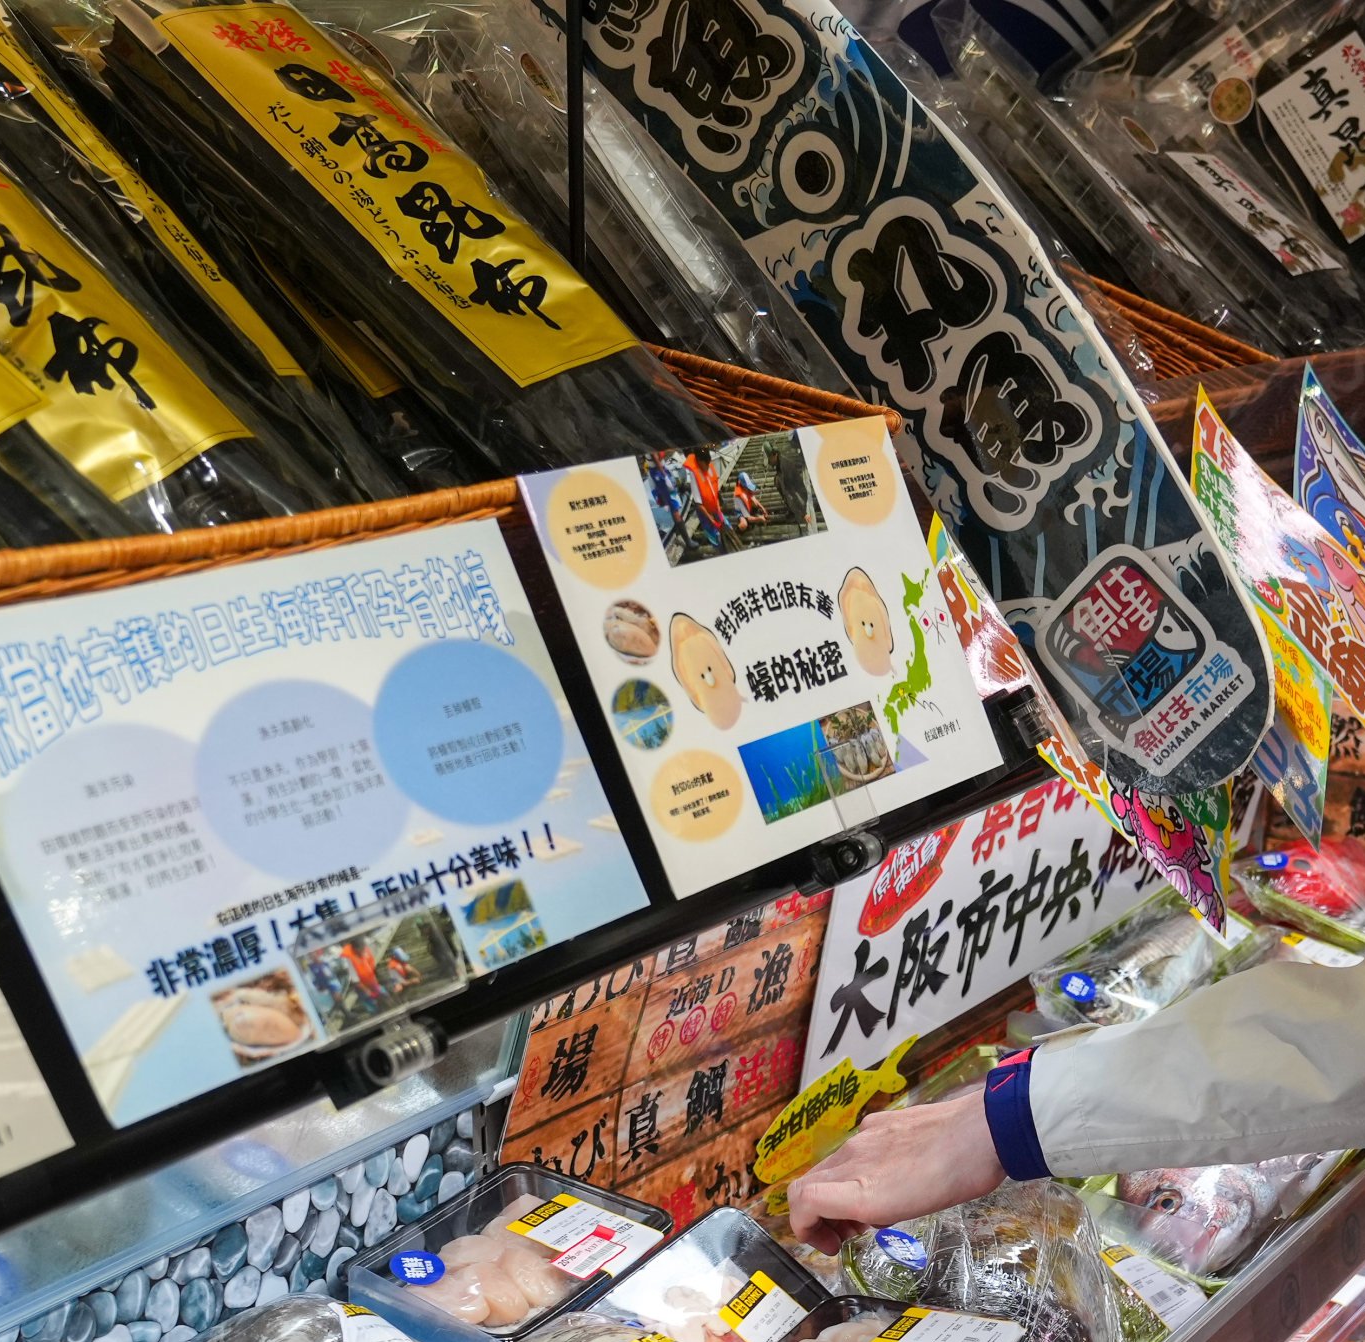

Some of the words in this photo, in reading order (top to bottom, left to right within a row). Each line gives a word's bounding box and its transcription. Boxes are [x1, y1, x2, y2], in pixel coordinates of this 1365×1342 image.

[212, 18, 312, 53] 特撰
[274, 64, 563, 330] 日高昆布
[713, 581, 835, 646] 對海洋也很友善
[745, 640, 849, 704] 蠔的秘密
[1133, 652, 1235, 758] 魚はま市場
[923, 718, 963, 745] 在這裡孕育！
[1152, 720, 1203, 767] UOHAMA
[1200, 673, 1245, 718] MARKET
[540, 1023, 600, 1102] 場
[733, 1036, 798, 1110] 活魚
[621, 1090, 666, 1173] 真
[763, 1070, 862, 1159] 油甘魚刺身
